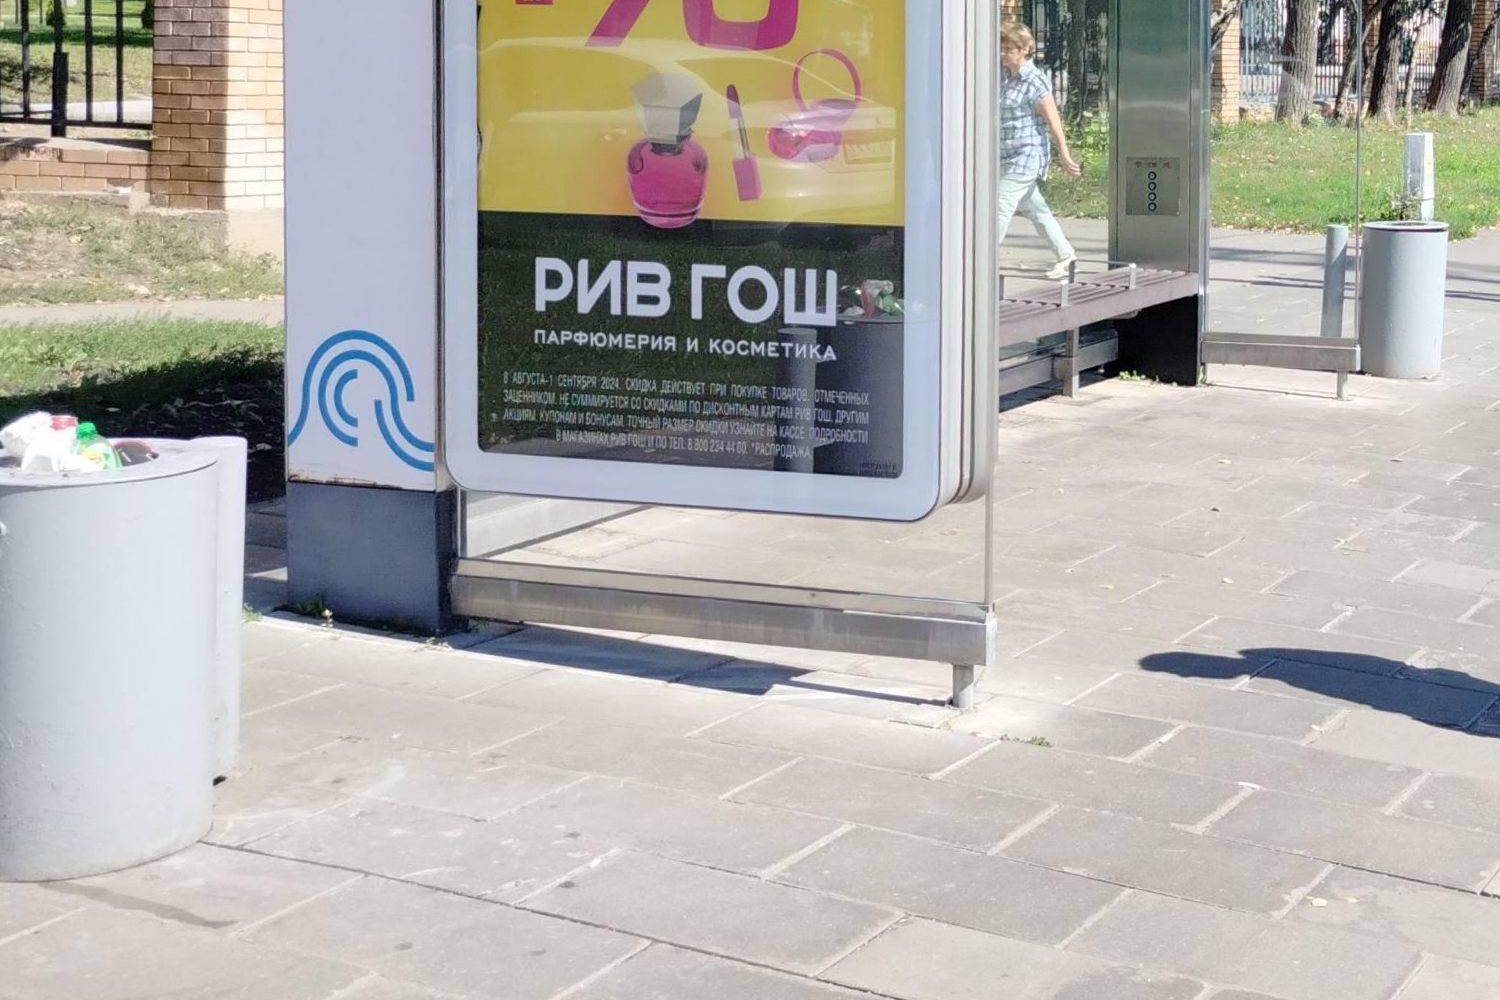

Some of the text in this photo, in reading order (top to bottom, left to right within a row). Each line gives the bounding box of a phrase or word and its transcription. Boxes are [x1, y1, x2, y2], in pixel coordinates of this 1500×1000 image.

[534, 256, 838, 327] РИВ ГОШ
[534, 329, 837, 361] ПАРФЮМЕРИЯ И КОСМЕТИКА
[557, 373, 598, 389] СЕНТЯБРЯ
[625, 377, 657, 393] СКИДКА
[660, 379, 705, 395] ДЕЙСТВУЕТ
[710, 383, 727, 397] ПРИ
[731, 384, 767, 399] ПОКУПКЕ
[814, 389, 869, 405] ОТМЕЧЕННЫХ
[559, 392, 569, 405] НЕ
[571, 394, 629, 409] СУММИРУЕТСЯ
[630, 396, 642, 410] СО
[643, 397, 687, 413] СКИДКАМИ
[689, 400, 701, 413] ПО
[703, 401, 759, 418] ДИСКОНТНЫМ
[761, 404, 793, 420] КАРТАМ
[795, 406, 811, 421] РИВ
[835, 409, 869, 425] ДРУГИМ
[539, 410, 577, 424] КУПОНАМ
[578, 412, 584, 425] И
[628, 414, 661, 429] ТОЧНЫЙ
[662, 417, 694, 432] РАЗМЕР
[695, 418, 728, 436] СКИДКИ
[767, 423, 778, 437] НА
[809, 427, 869, 444] ПОДРОБНОСТИ
